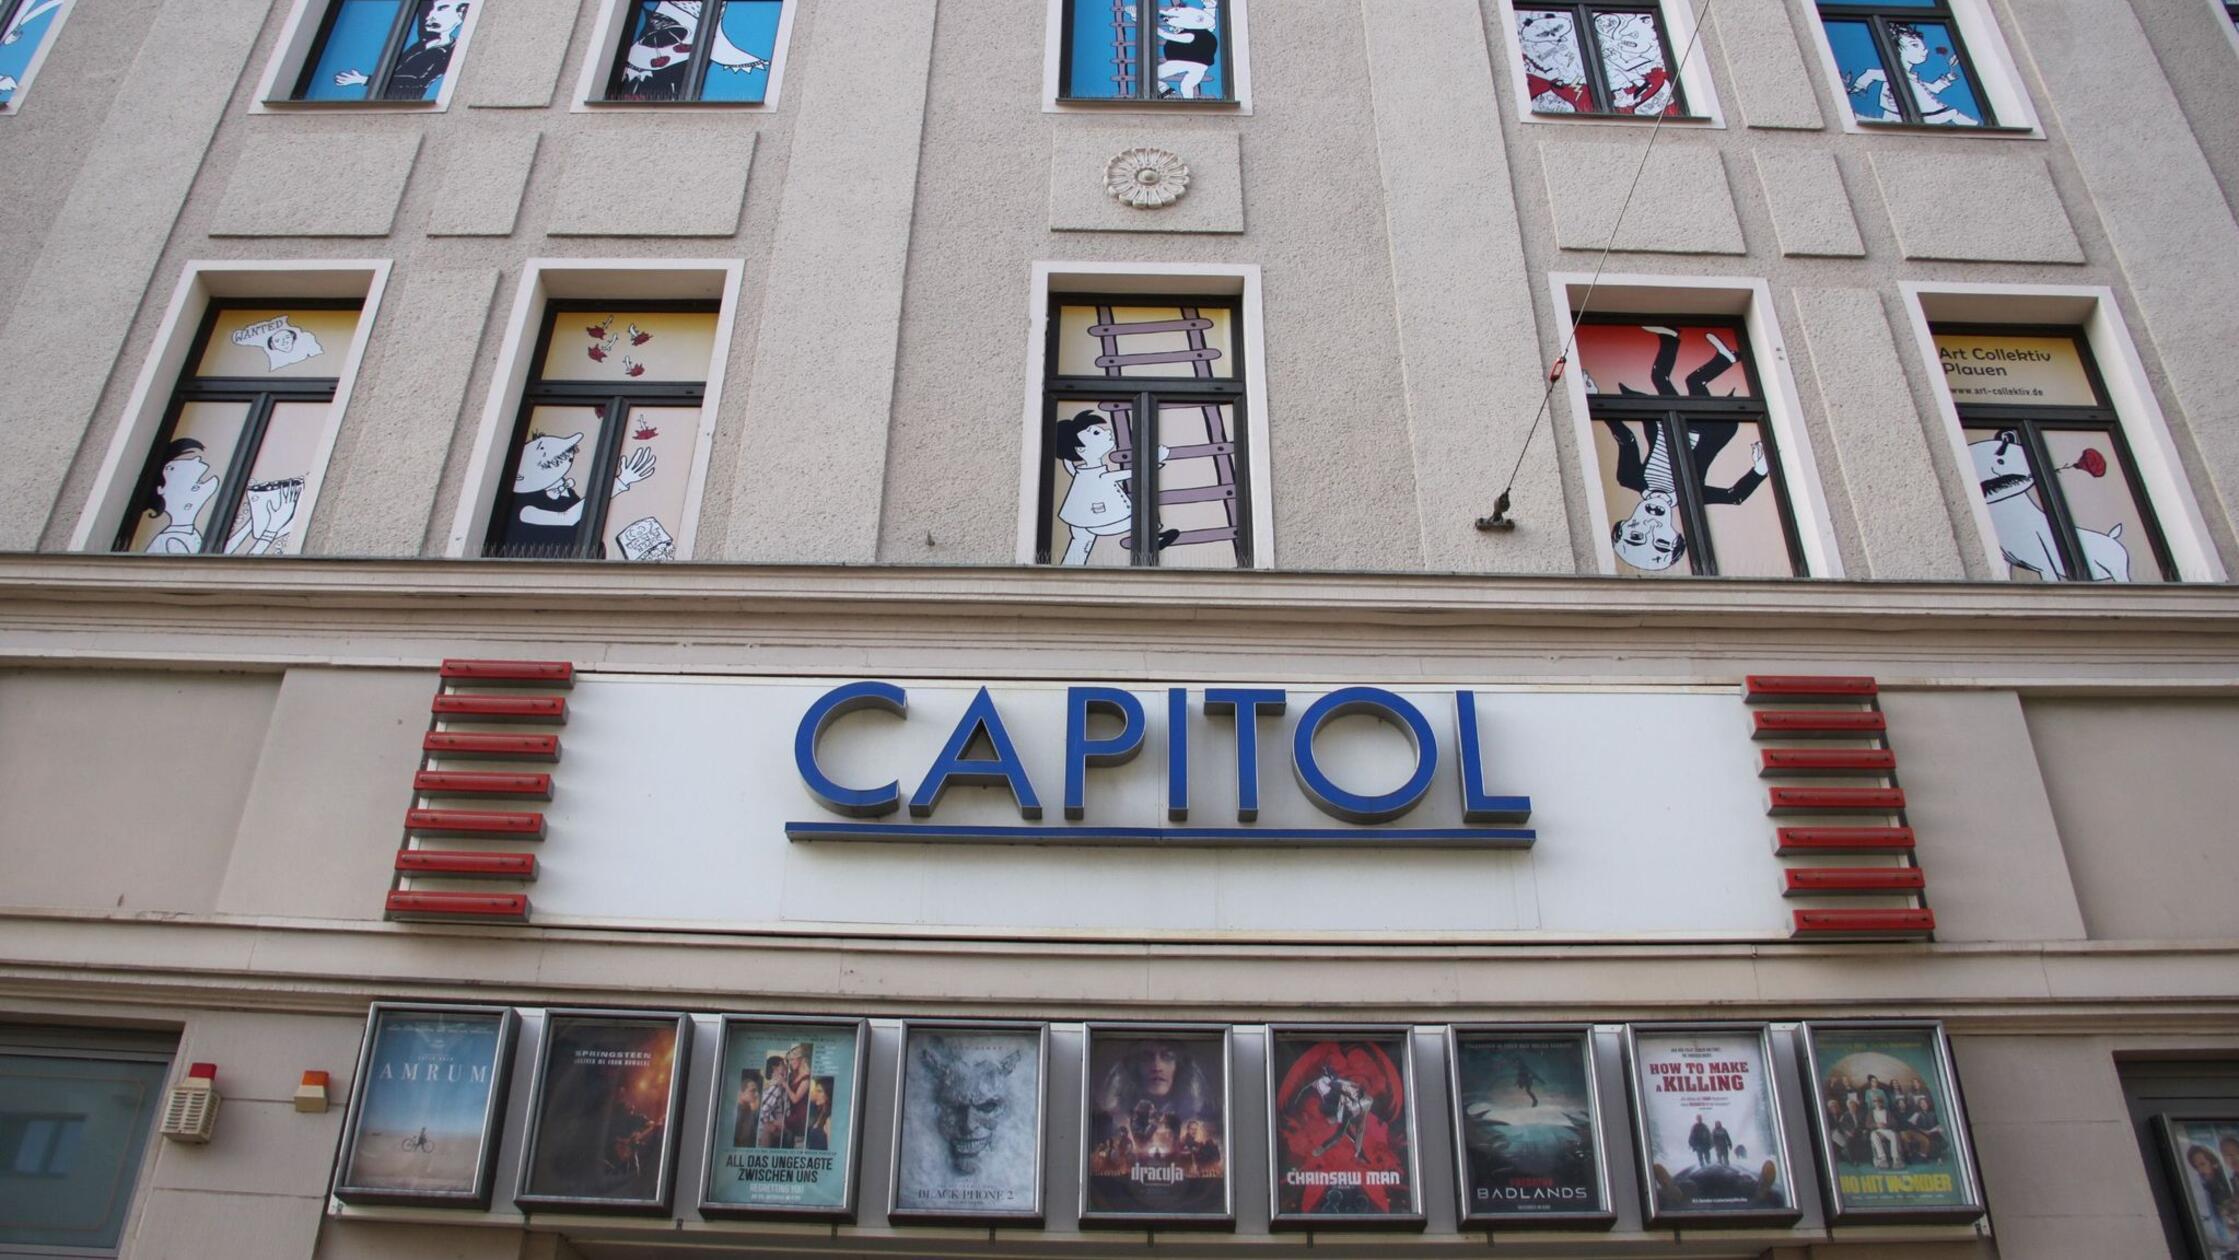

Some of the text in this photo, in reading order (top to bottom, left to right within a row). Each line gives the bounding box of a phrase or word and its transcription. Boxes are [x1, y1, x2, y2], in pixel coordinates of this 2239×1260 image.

[235, 320, 283, 342] WANTED
[1940, 347, 2051, 362] Art Collektiv
[1943, 362, 2007, 376] Plauen
[794, 680, 1532, 824] CAPITOL
[575, 1049, 652, 1059] SPRINGSTEEN
[379, 1062, 488, 1083] AMRUM
[1649, 1061, 1749, 1075] HOW TO MAKE
[1662, 1074, 1745, 1093] KILLING
[726, 1155, 833, 1171] ALL DAS UNGESAGTE
[738, 1168, 818, 1183] ZWISCHEN UNS
[1131, 1162, 1184, 1184] dracula
[1477, 1187, 1587, 1200] BADLANDS
